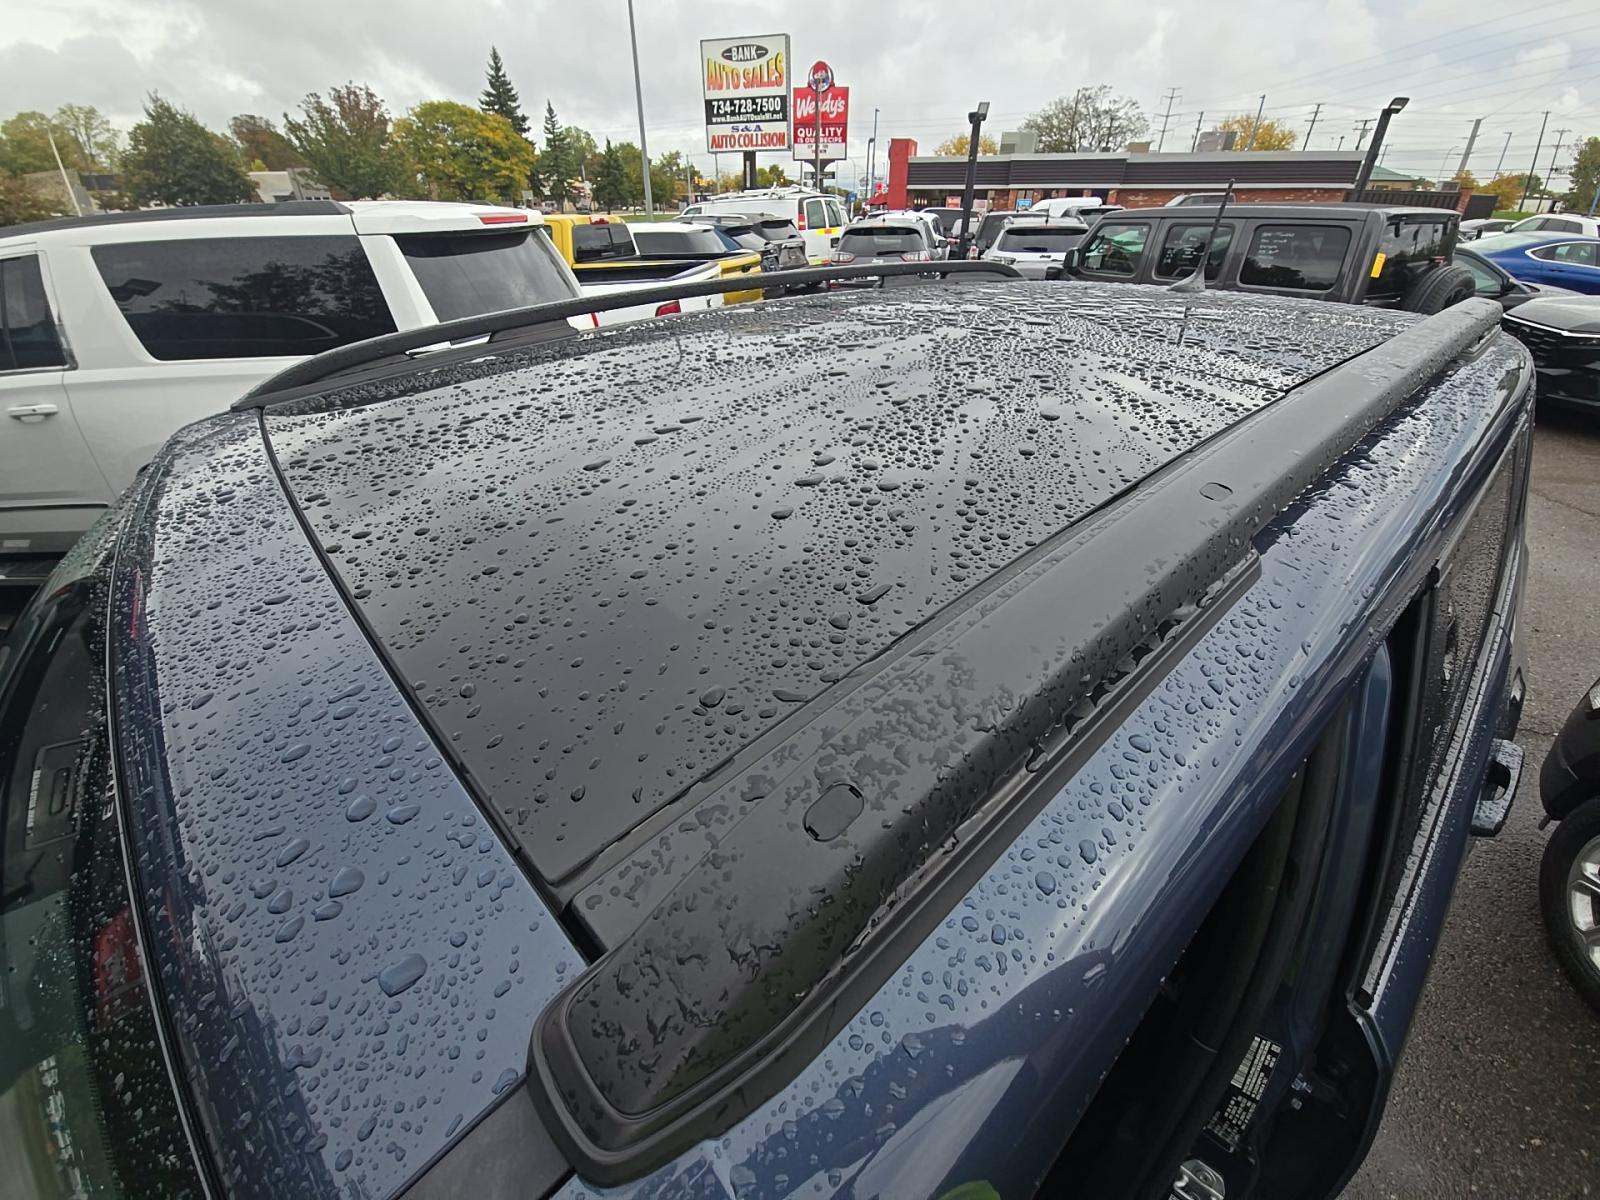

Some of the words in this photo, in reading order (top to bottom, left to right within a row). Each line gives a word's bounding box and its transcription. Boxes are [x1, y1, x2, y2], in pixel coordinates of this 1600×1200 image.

[731, 45, 757, 61] BANK
[707, 57, 741, 91] AUTO
[743, 51, 784, 89] SALES
[712, 97, 782, 114] 734-728-7500
[731, 124, 764, 133] S&A
[797, 127, 843, 138] QULITY
[710, 134, 736, 149] AUTO
[737, 132, 786, 148] COLLISION
